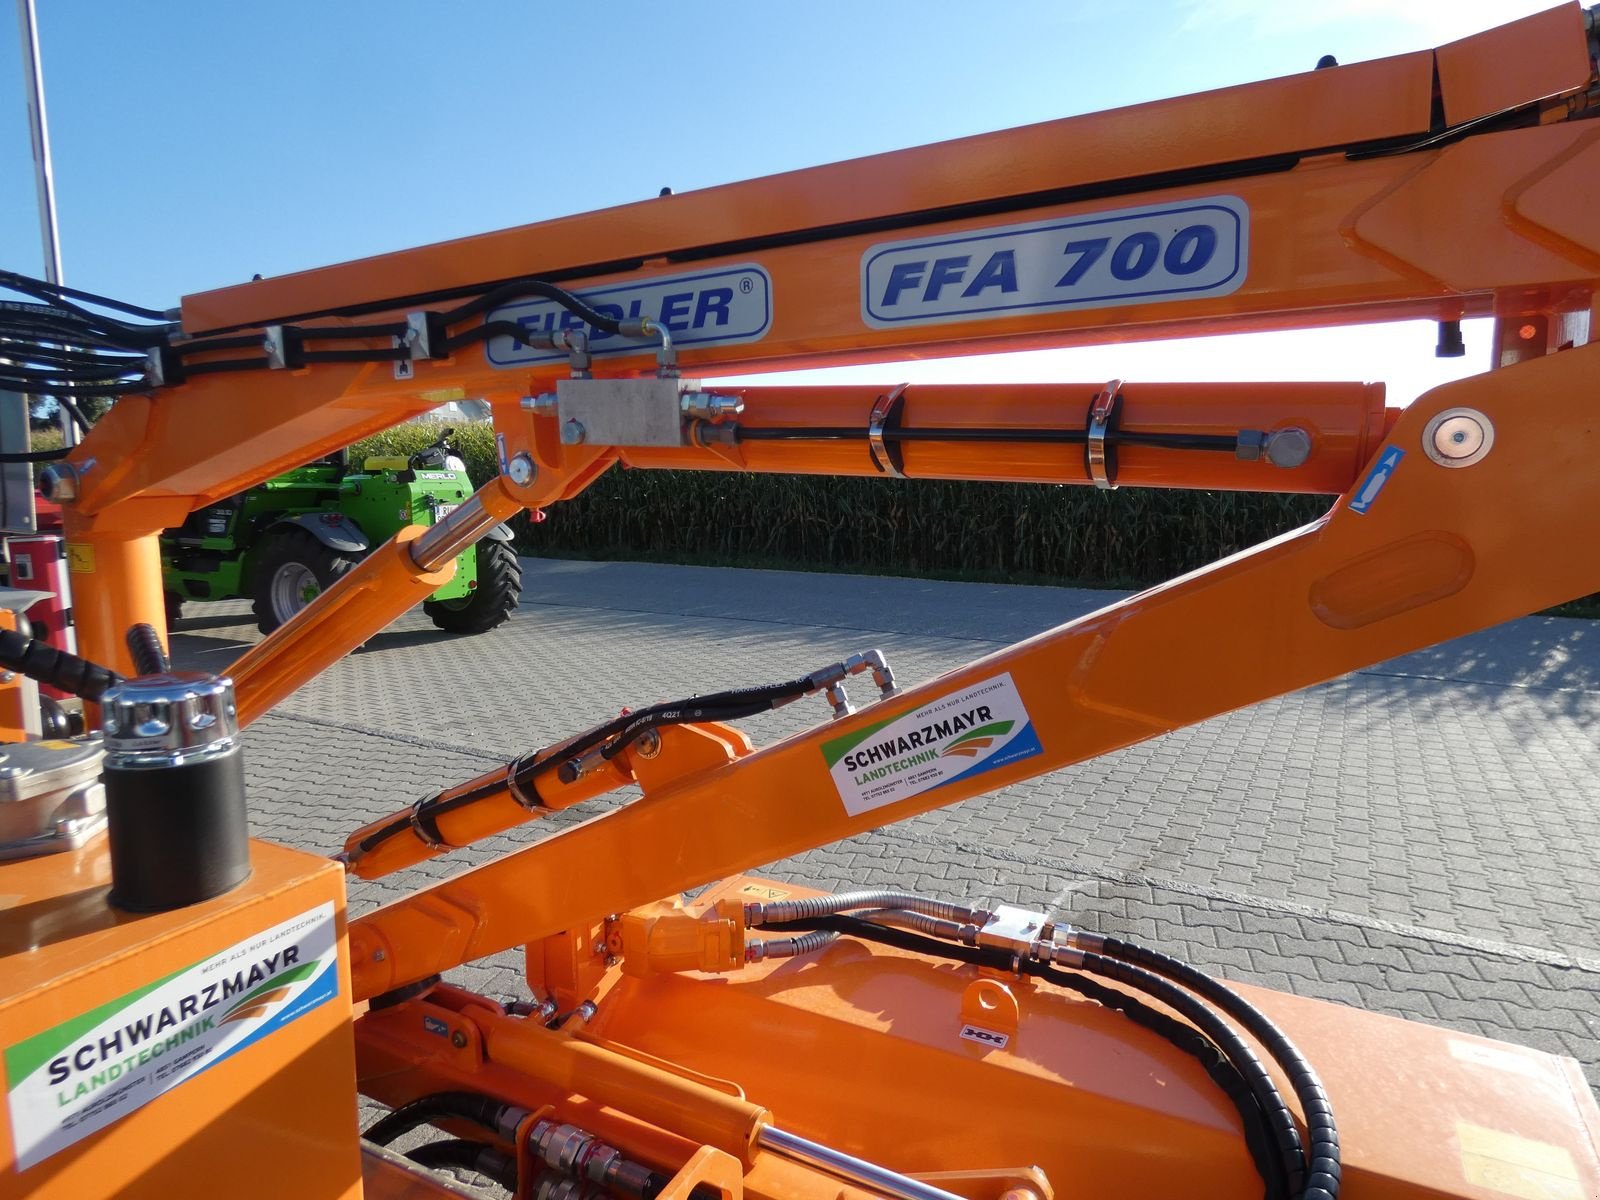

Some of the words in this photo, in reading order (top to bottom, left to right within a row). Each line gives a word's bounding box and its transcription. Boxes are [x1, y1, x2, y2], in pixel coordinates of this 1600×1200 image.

[880, 250, 1019, 306] FFA
[1054, 224, 1218, 287] 700
[916, 709, 932, 719] MEHR
[933, 704, 946, 712] ALS
[946, 698, 960, 707] NUR
[960, 680, 1006, 702] LANDTECHNIK.
[842, 704, 994, 772] SCHWARZMAYR
[854, 747, 939, 786] LANDTECHNIK
[202, 957, 226, 974] MEHR
[230, 948, 246, 961] ALS
[249, 939, 266, 952] NUR
[47, 942, 300, 1087] SCHWARZMAYR
[58, 1013, 215, 1108] LANDTECHNIK
